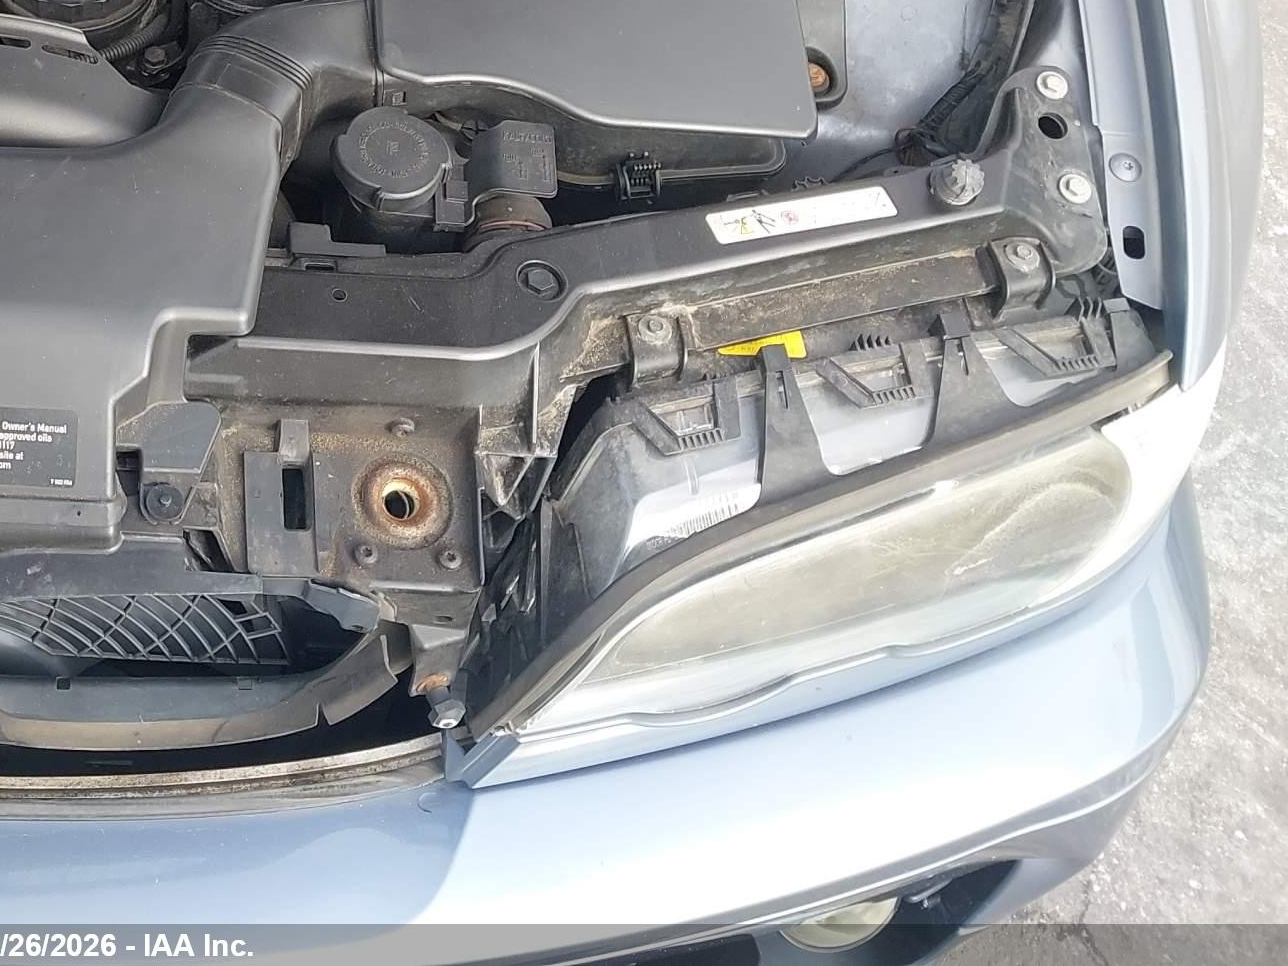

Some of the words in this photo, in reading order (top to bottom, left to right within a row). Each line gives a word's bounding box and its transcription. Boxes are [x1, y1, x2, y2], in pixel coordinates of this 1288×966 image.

[2, 421, 36, 432] Owner's
[37, 422, 67, 434] Manual
[37, 433, 53, 443] oils
[15, 451, 24, 461] at
